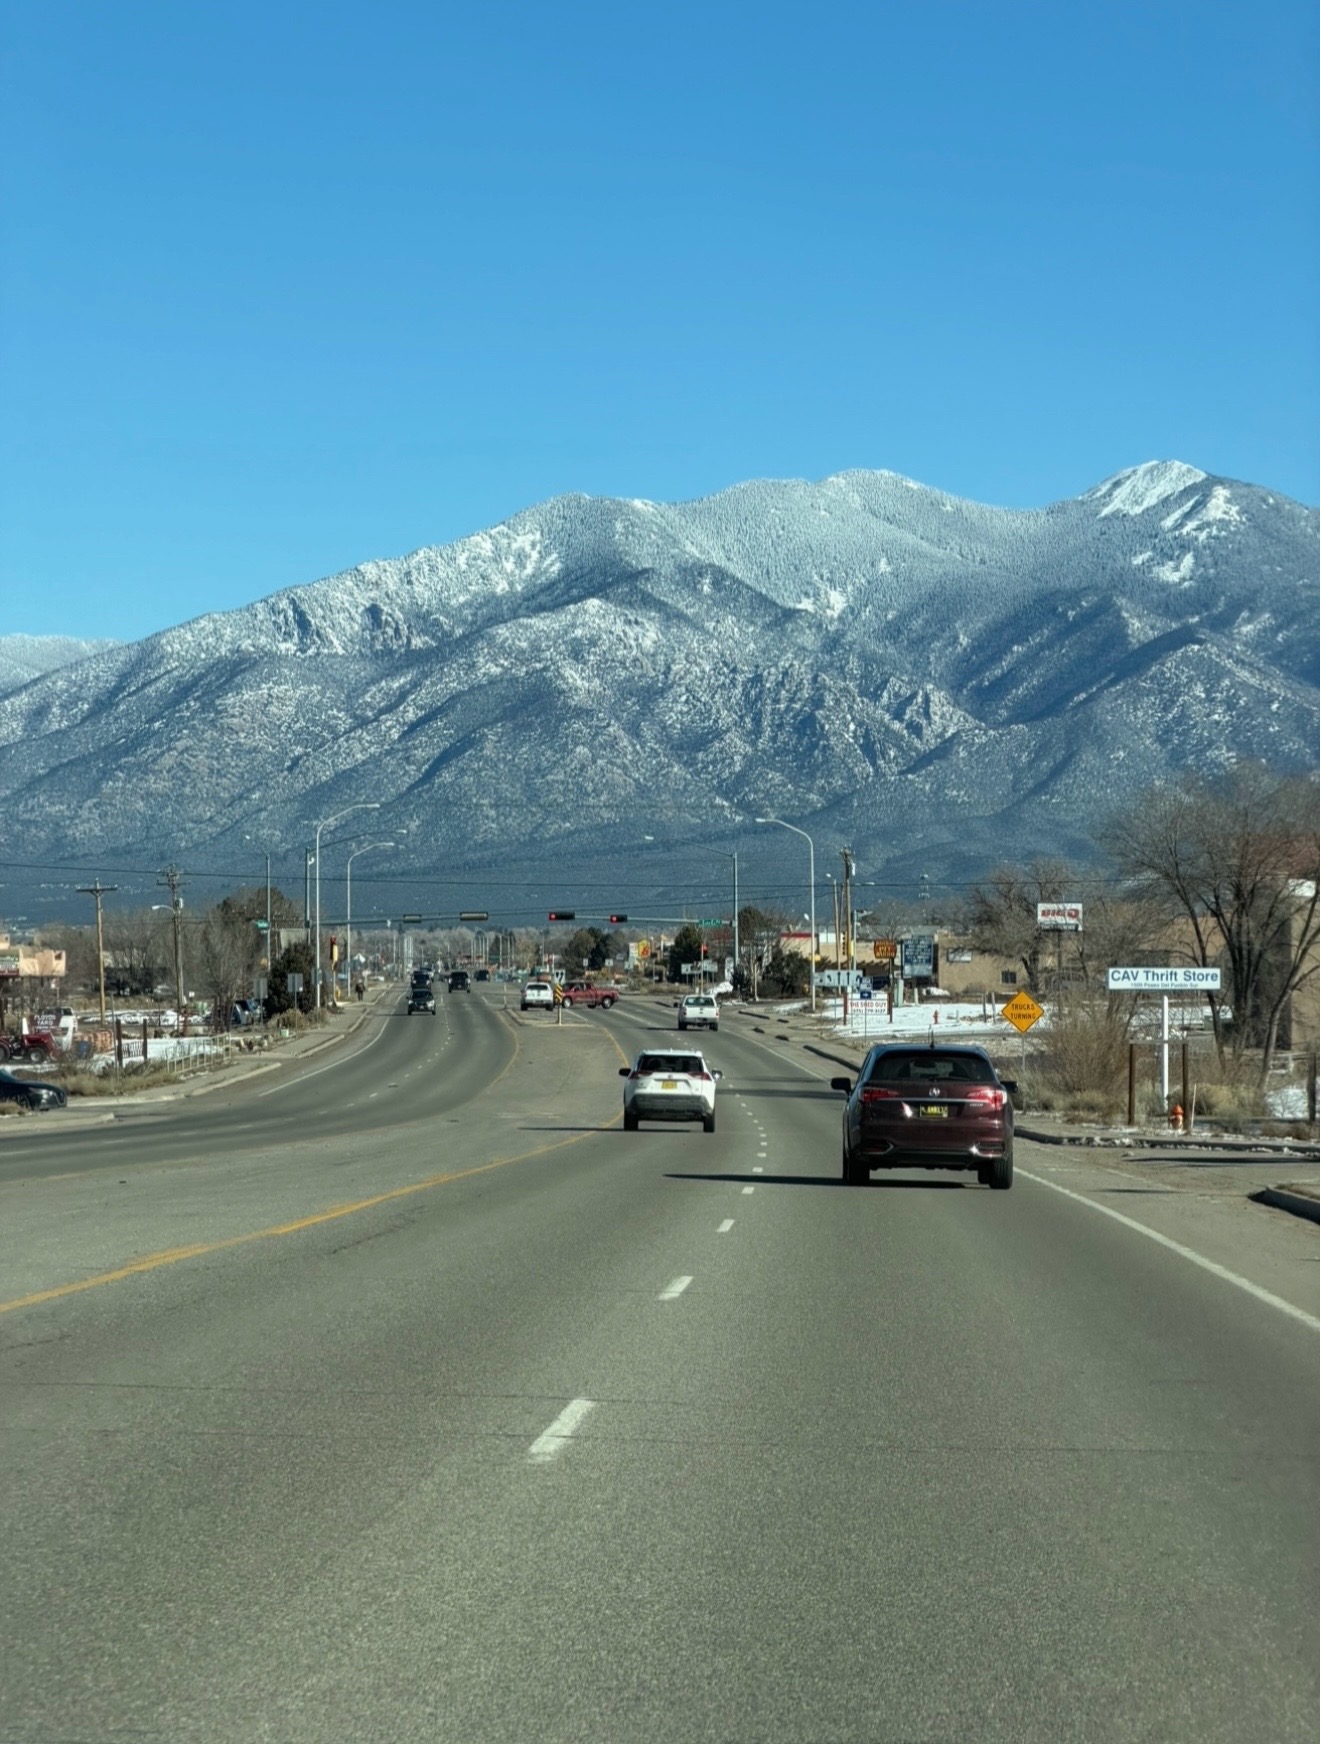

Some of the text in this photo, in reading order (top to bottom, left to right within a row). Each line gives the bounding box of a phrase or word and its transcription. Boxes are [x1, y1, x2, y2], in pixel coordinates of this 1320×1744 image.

[1111, 970, 1218, 982] CAV Thrift Store
